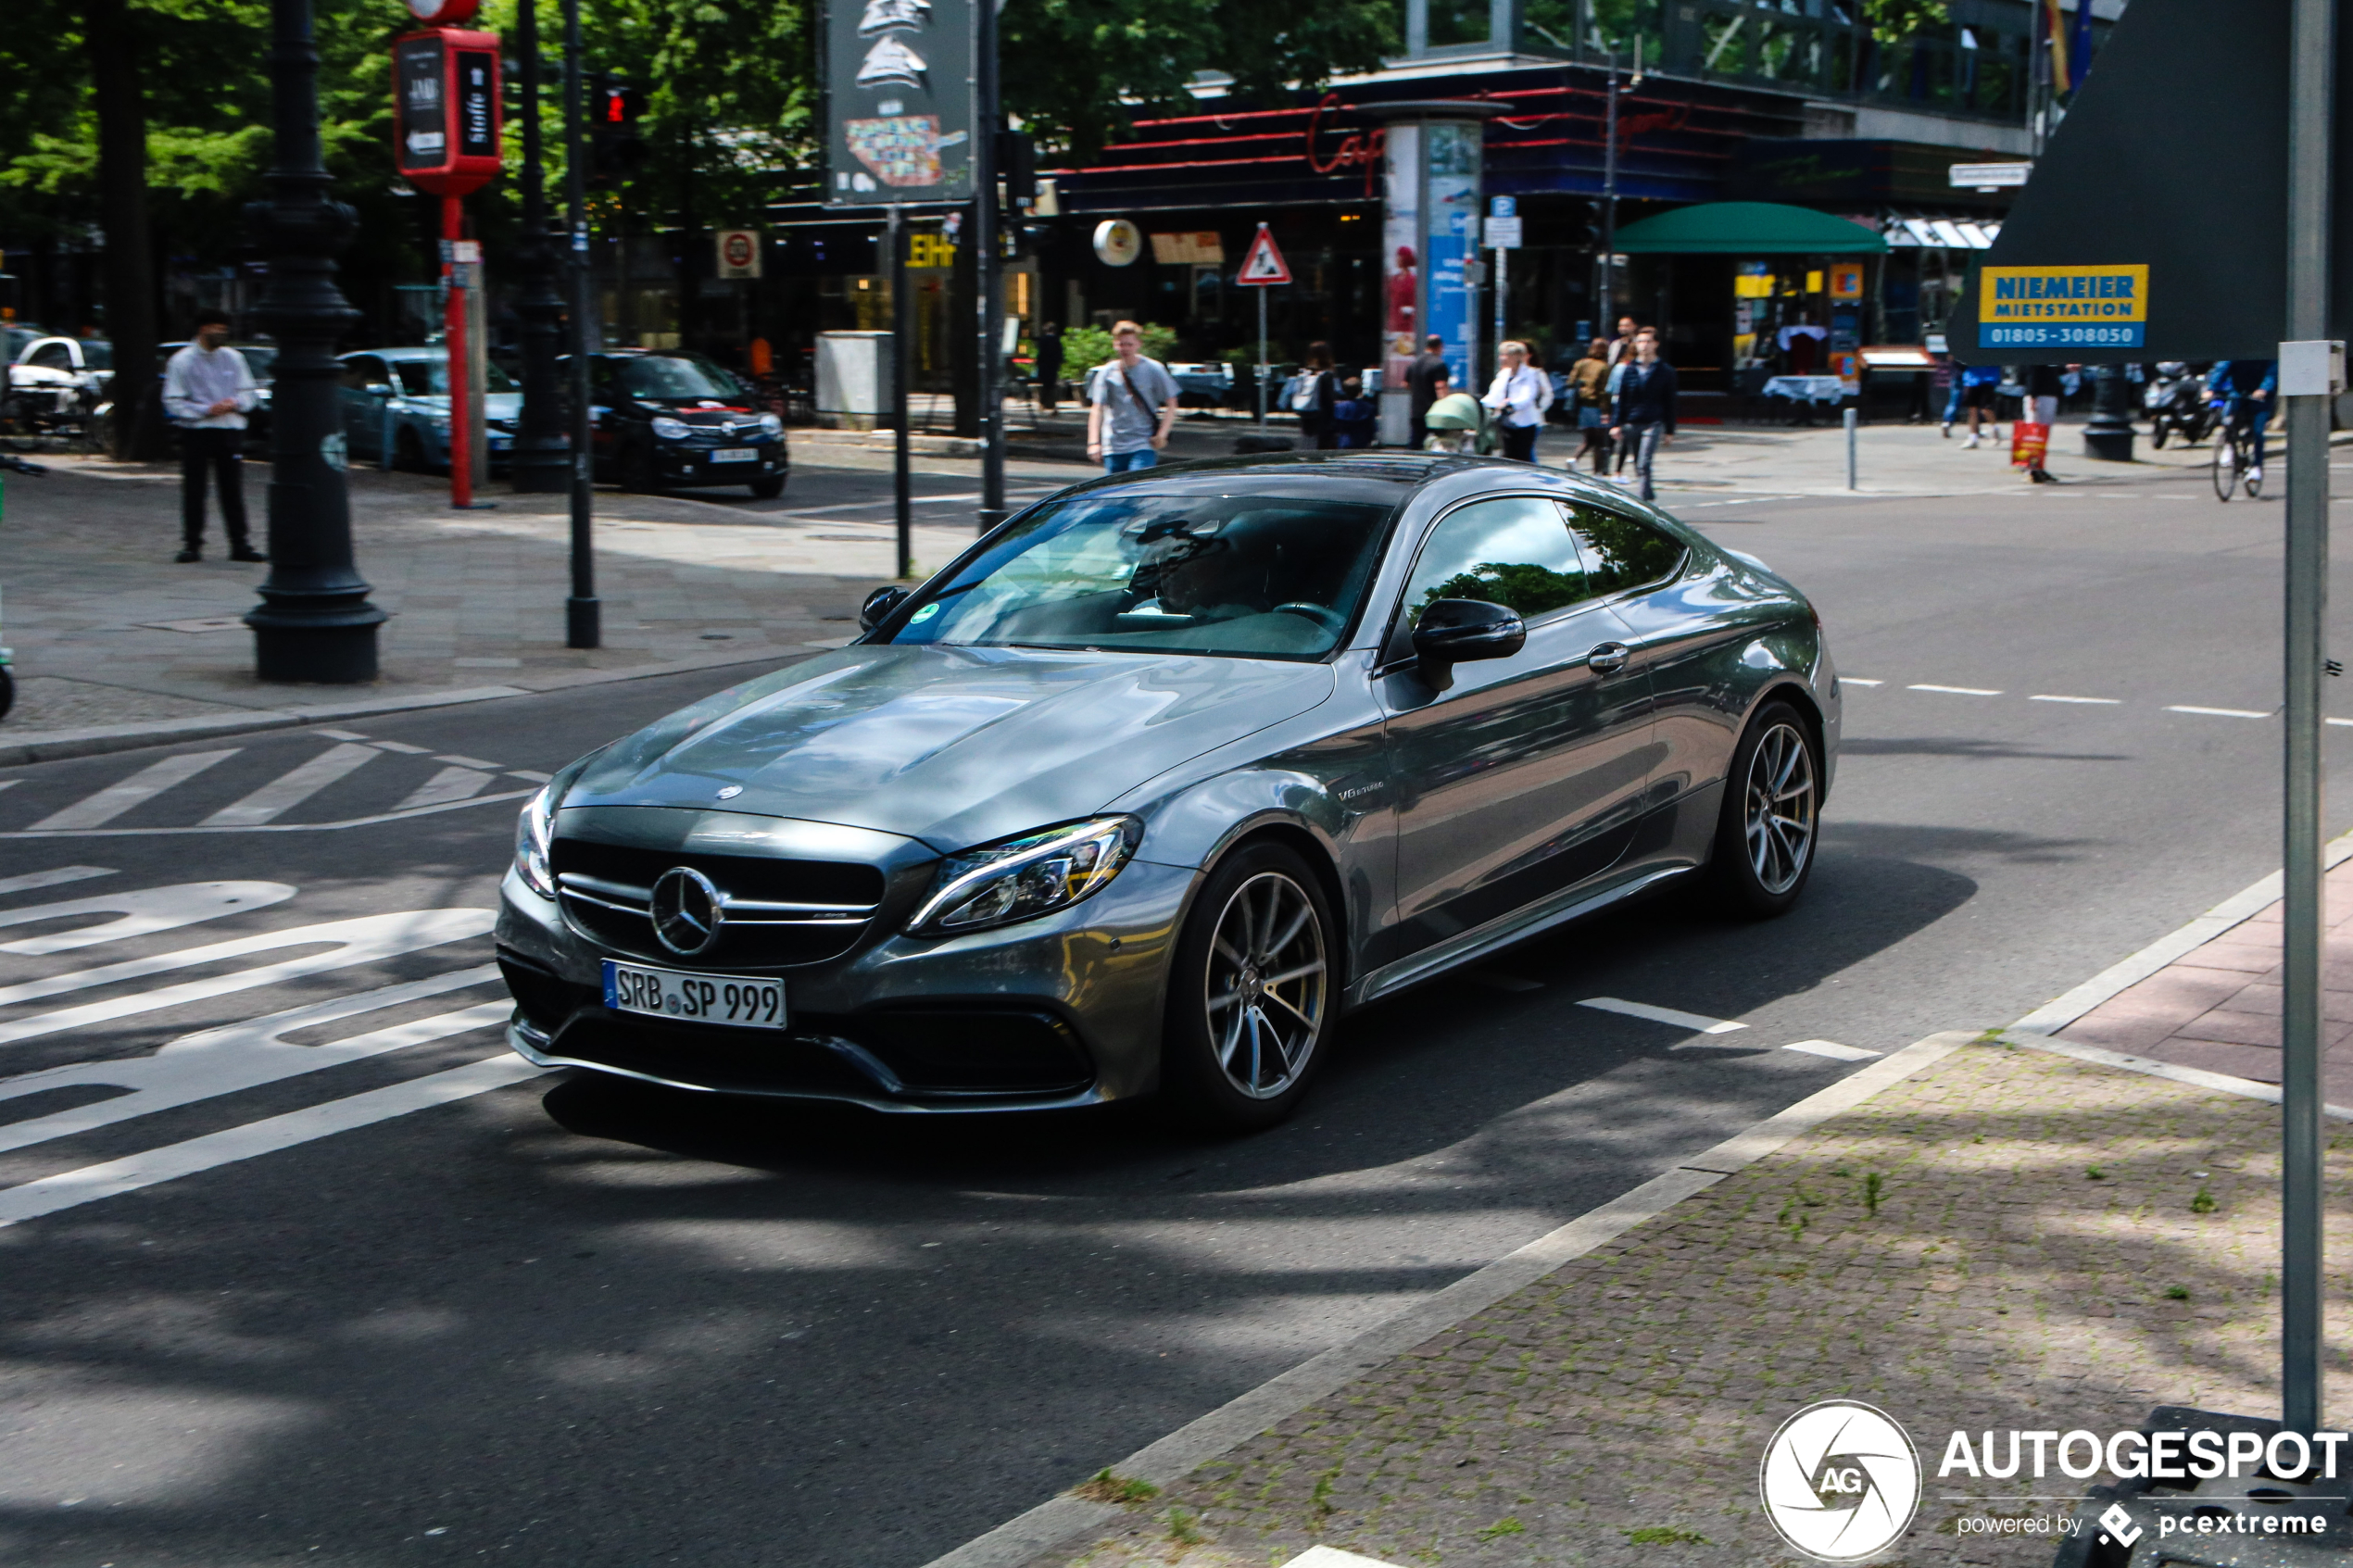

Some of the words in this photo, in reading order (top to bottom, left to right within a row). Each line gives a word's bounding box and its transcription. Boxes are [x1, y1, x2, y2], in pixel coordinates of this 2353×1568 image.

[1995, 276, 2134, 299] NIEMEIER
[1994, 303, 2133, 317] MIETSTATION
[618, 969, 662, 1010] SRB
[682, 979, 715, 1016] SP
[724, 983, 778, 1022] 999
